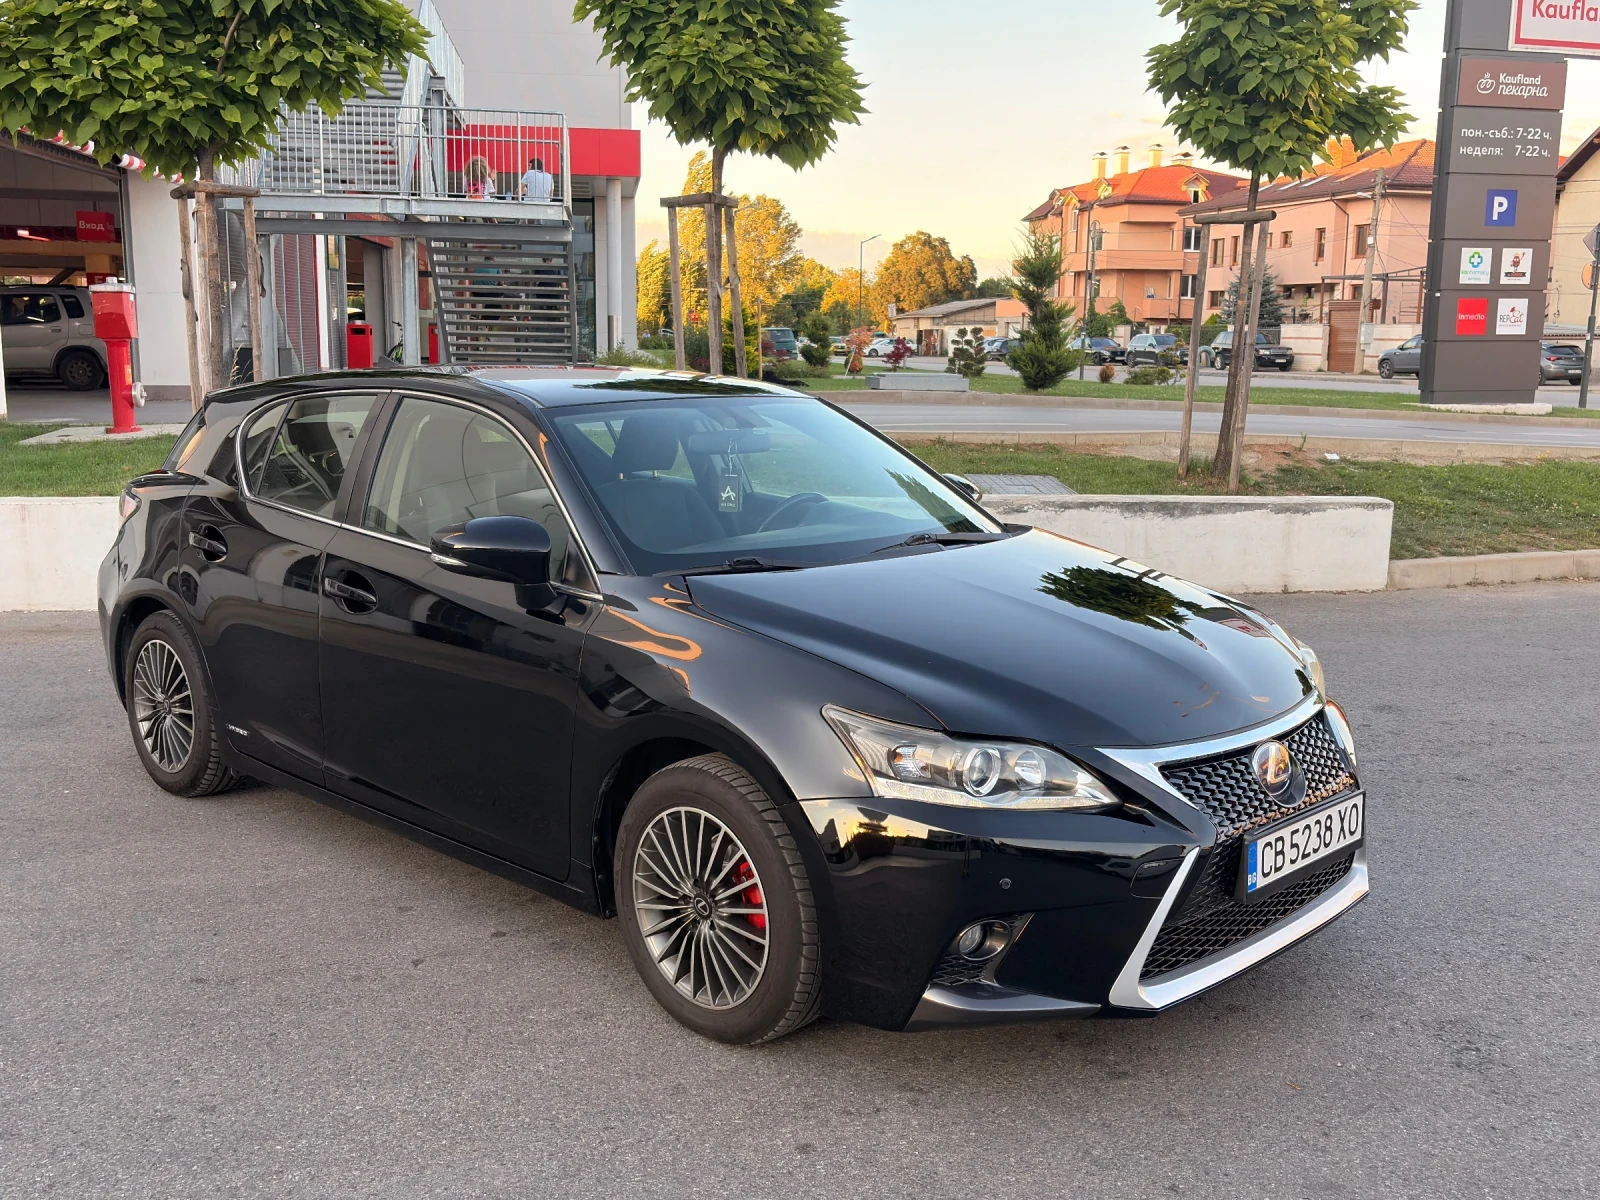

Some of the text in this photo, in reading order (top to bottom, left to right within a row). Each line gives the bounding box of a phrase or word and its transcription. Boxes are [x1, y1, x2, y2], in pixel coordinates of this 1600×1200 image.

[1532, 0, 1600, 22] Kaufla
[1499, 73, 1541, 84] Kaufland
[1498, 84, 1549, 98] пекарна
[1516, 128, 1541, 140] 7-22
[1459, 146, 1504, 157] неделя:
[1515, 145, 1539, 157] 7-22
[1492, 196, 1508, 221] P
[79, 221, 105, 231] Вход
[1458, 313, 1485, 321] inmedio
[1289, 814, 1333, 865] 5238
[1247, 872, 1257, 886] BG
